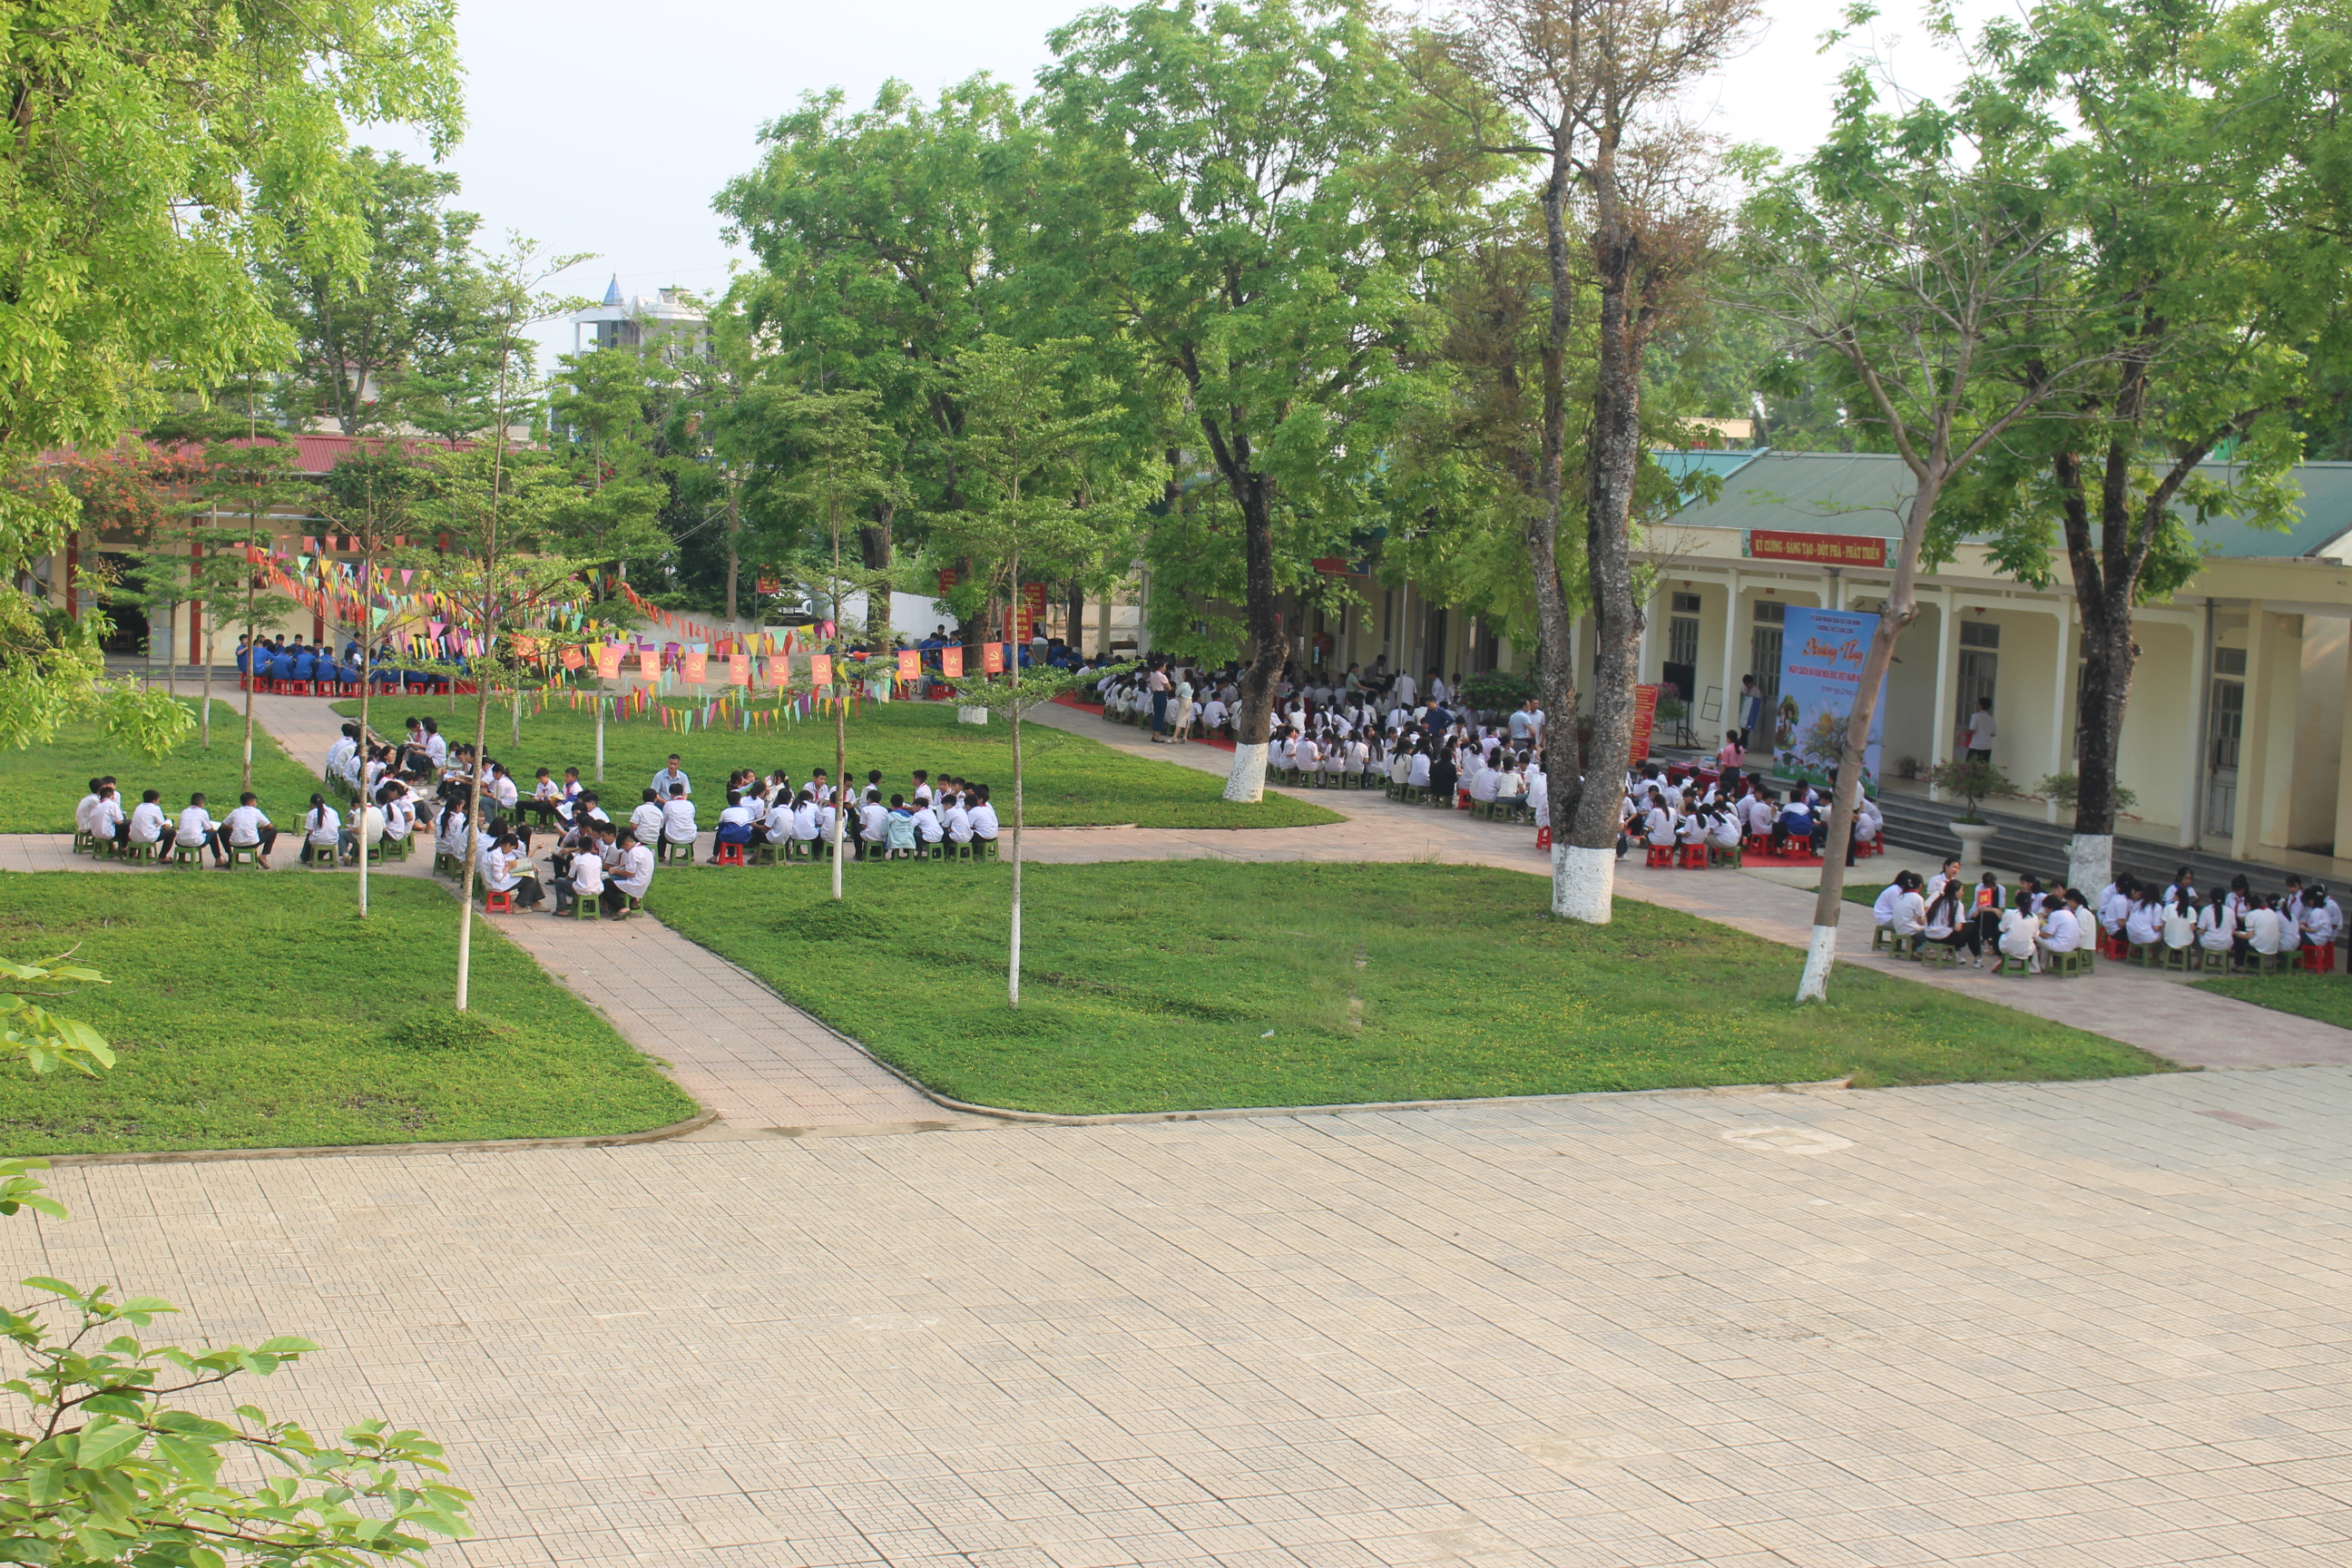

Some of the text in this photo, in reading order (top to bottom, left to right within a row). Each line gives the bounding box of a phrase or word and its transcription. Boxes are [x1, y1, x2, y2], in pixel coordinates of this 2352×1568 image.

[1786, 538, 1801, 554] SÁNG
[1802, 543, 1814, 558] TẠO
[1829, 542, 1842, 557] PHÁ
[1846, 543, 1861, 559] PHÁT
